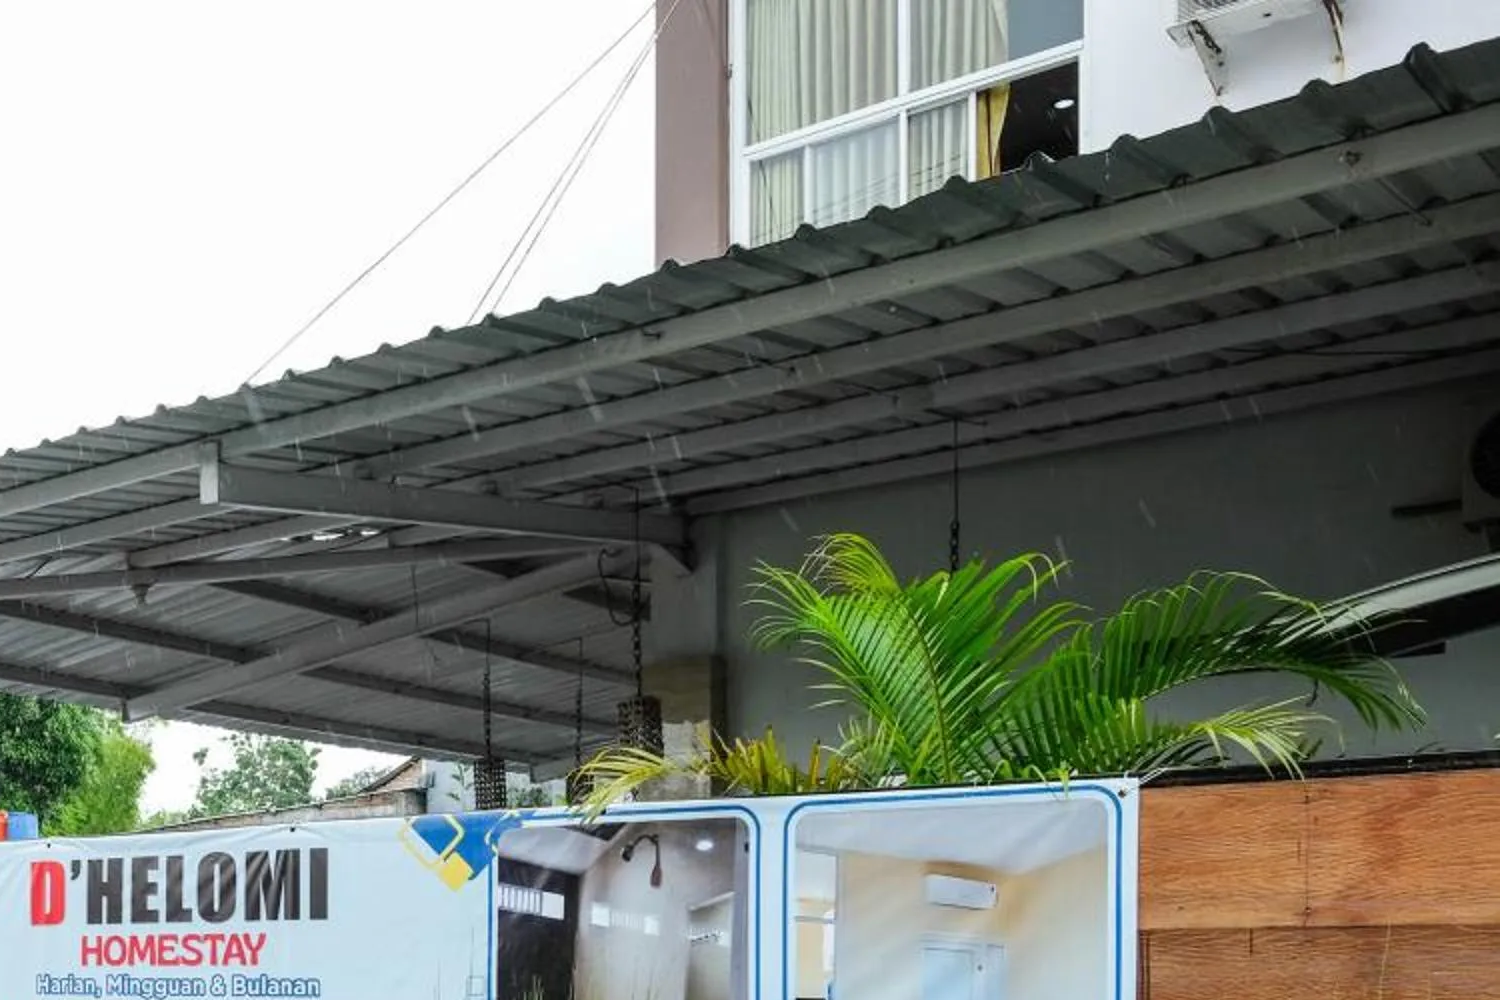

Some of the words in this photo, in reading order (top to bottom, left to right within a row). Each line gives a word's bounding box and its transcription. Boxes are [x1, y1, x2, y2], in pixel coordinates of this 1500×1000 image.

[30, 848, 329, 926] D'HELOMI
[80, 933, 267, 967] HOMESTAY
[36, 974, 101, 998] Harian,
[106, 974, 206, 999] Mingguan
[209, 975, 227, 997] &
[231, 974, 321, 998] Bulanan
